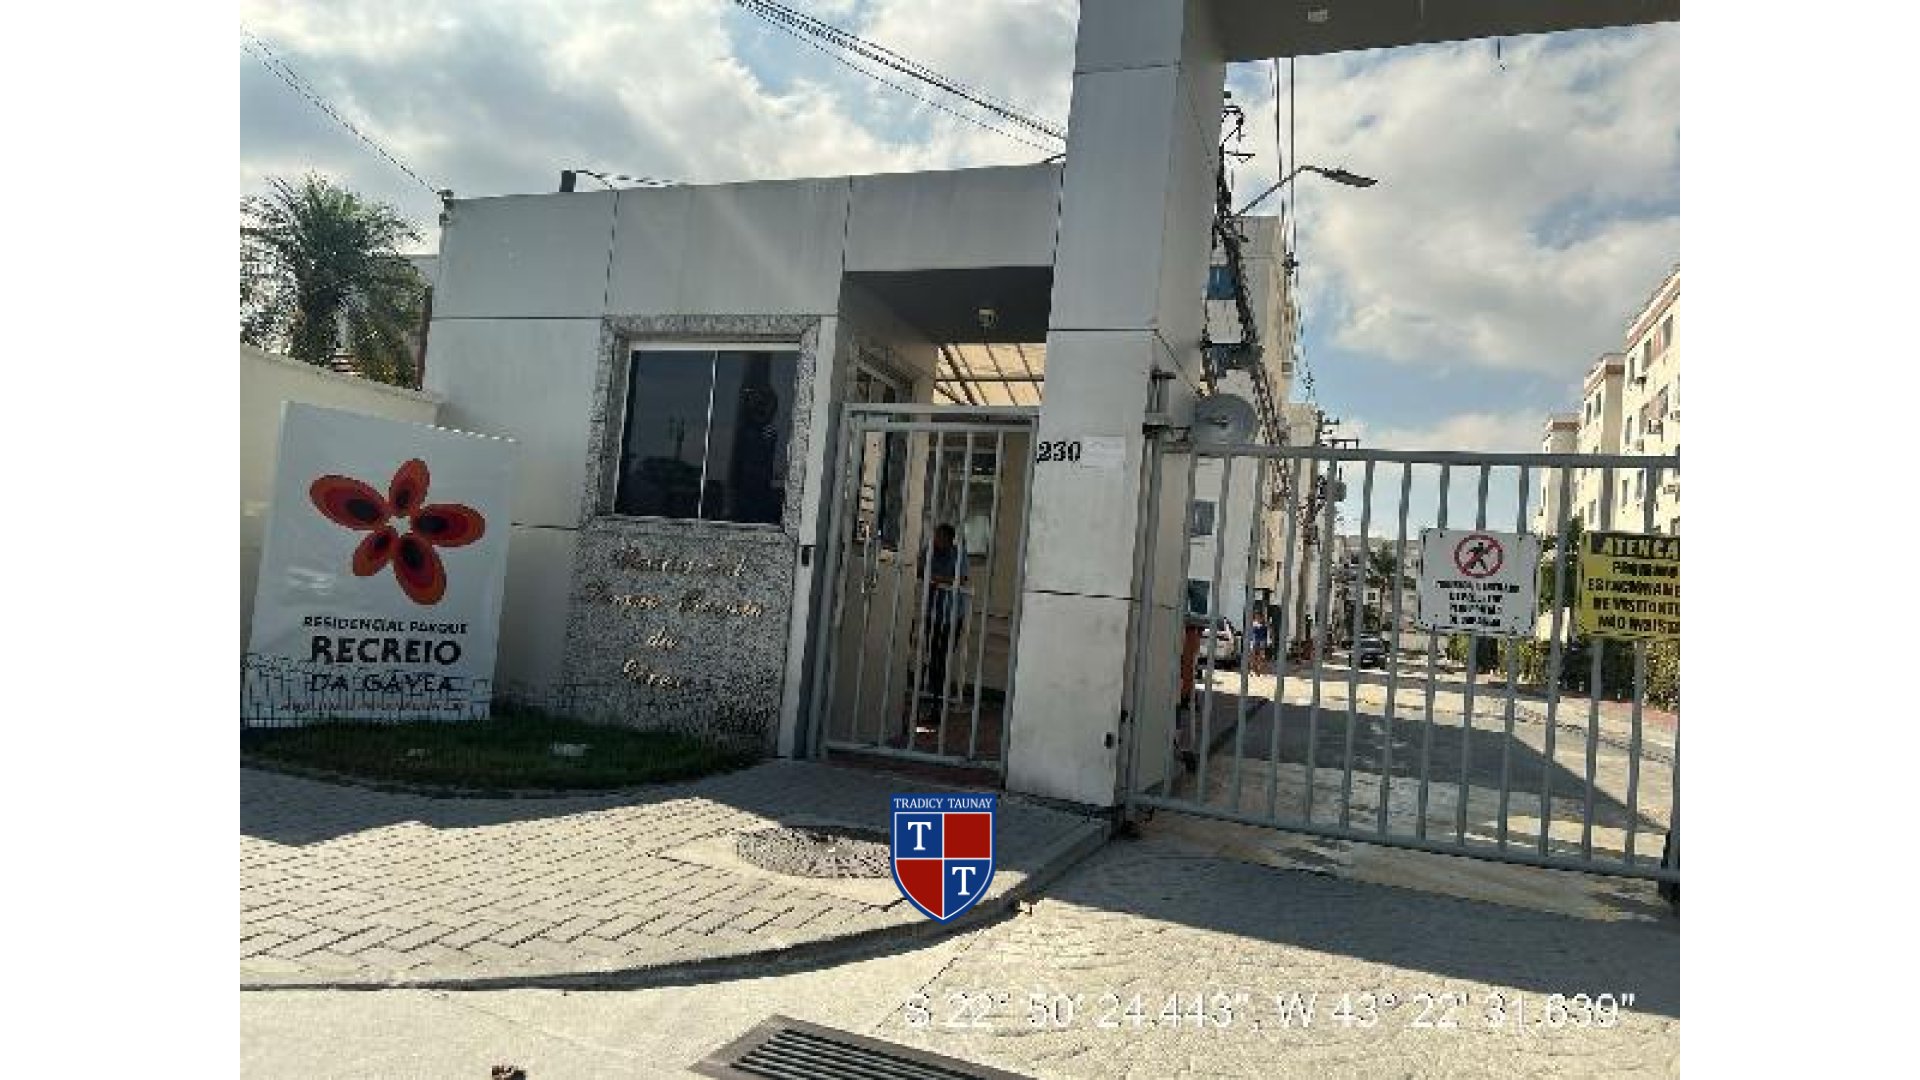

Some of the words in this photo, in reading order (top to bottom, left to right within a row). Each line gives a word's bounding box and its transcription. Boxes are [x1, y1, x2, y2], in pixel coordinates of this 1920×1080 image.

[1037, 441, 1080, 463] 230
[304, 616, 405, 632] RESIDENCIAL
[409, 621, 468, 634] PARQUE
[311, 635, 462, 665] RECREIO
[311, 673, 348, 692] DA
